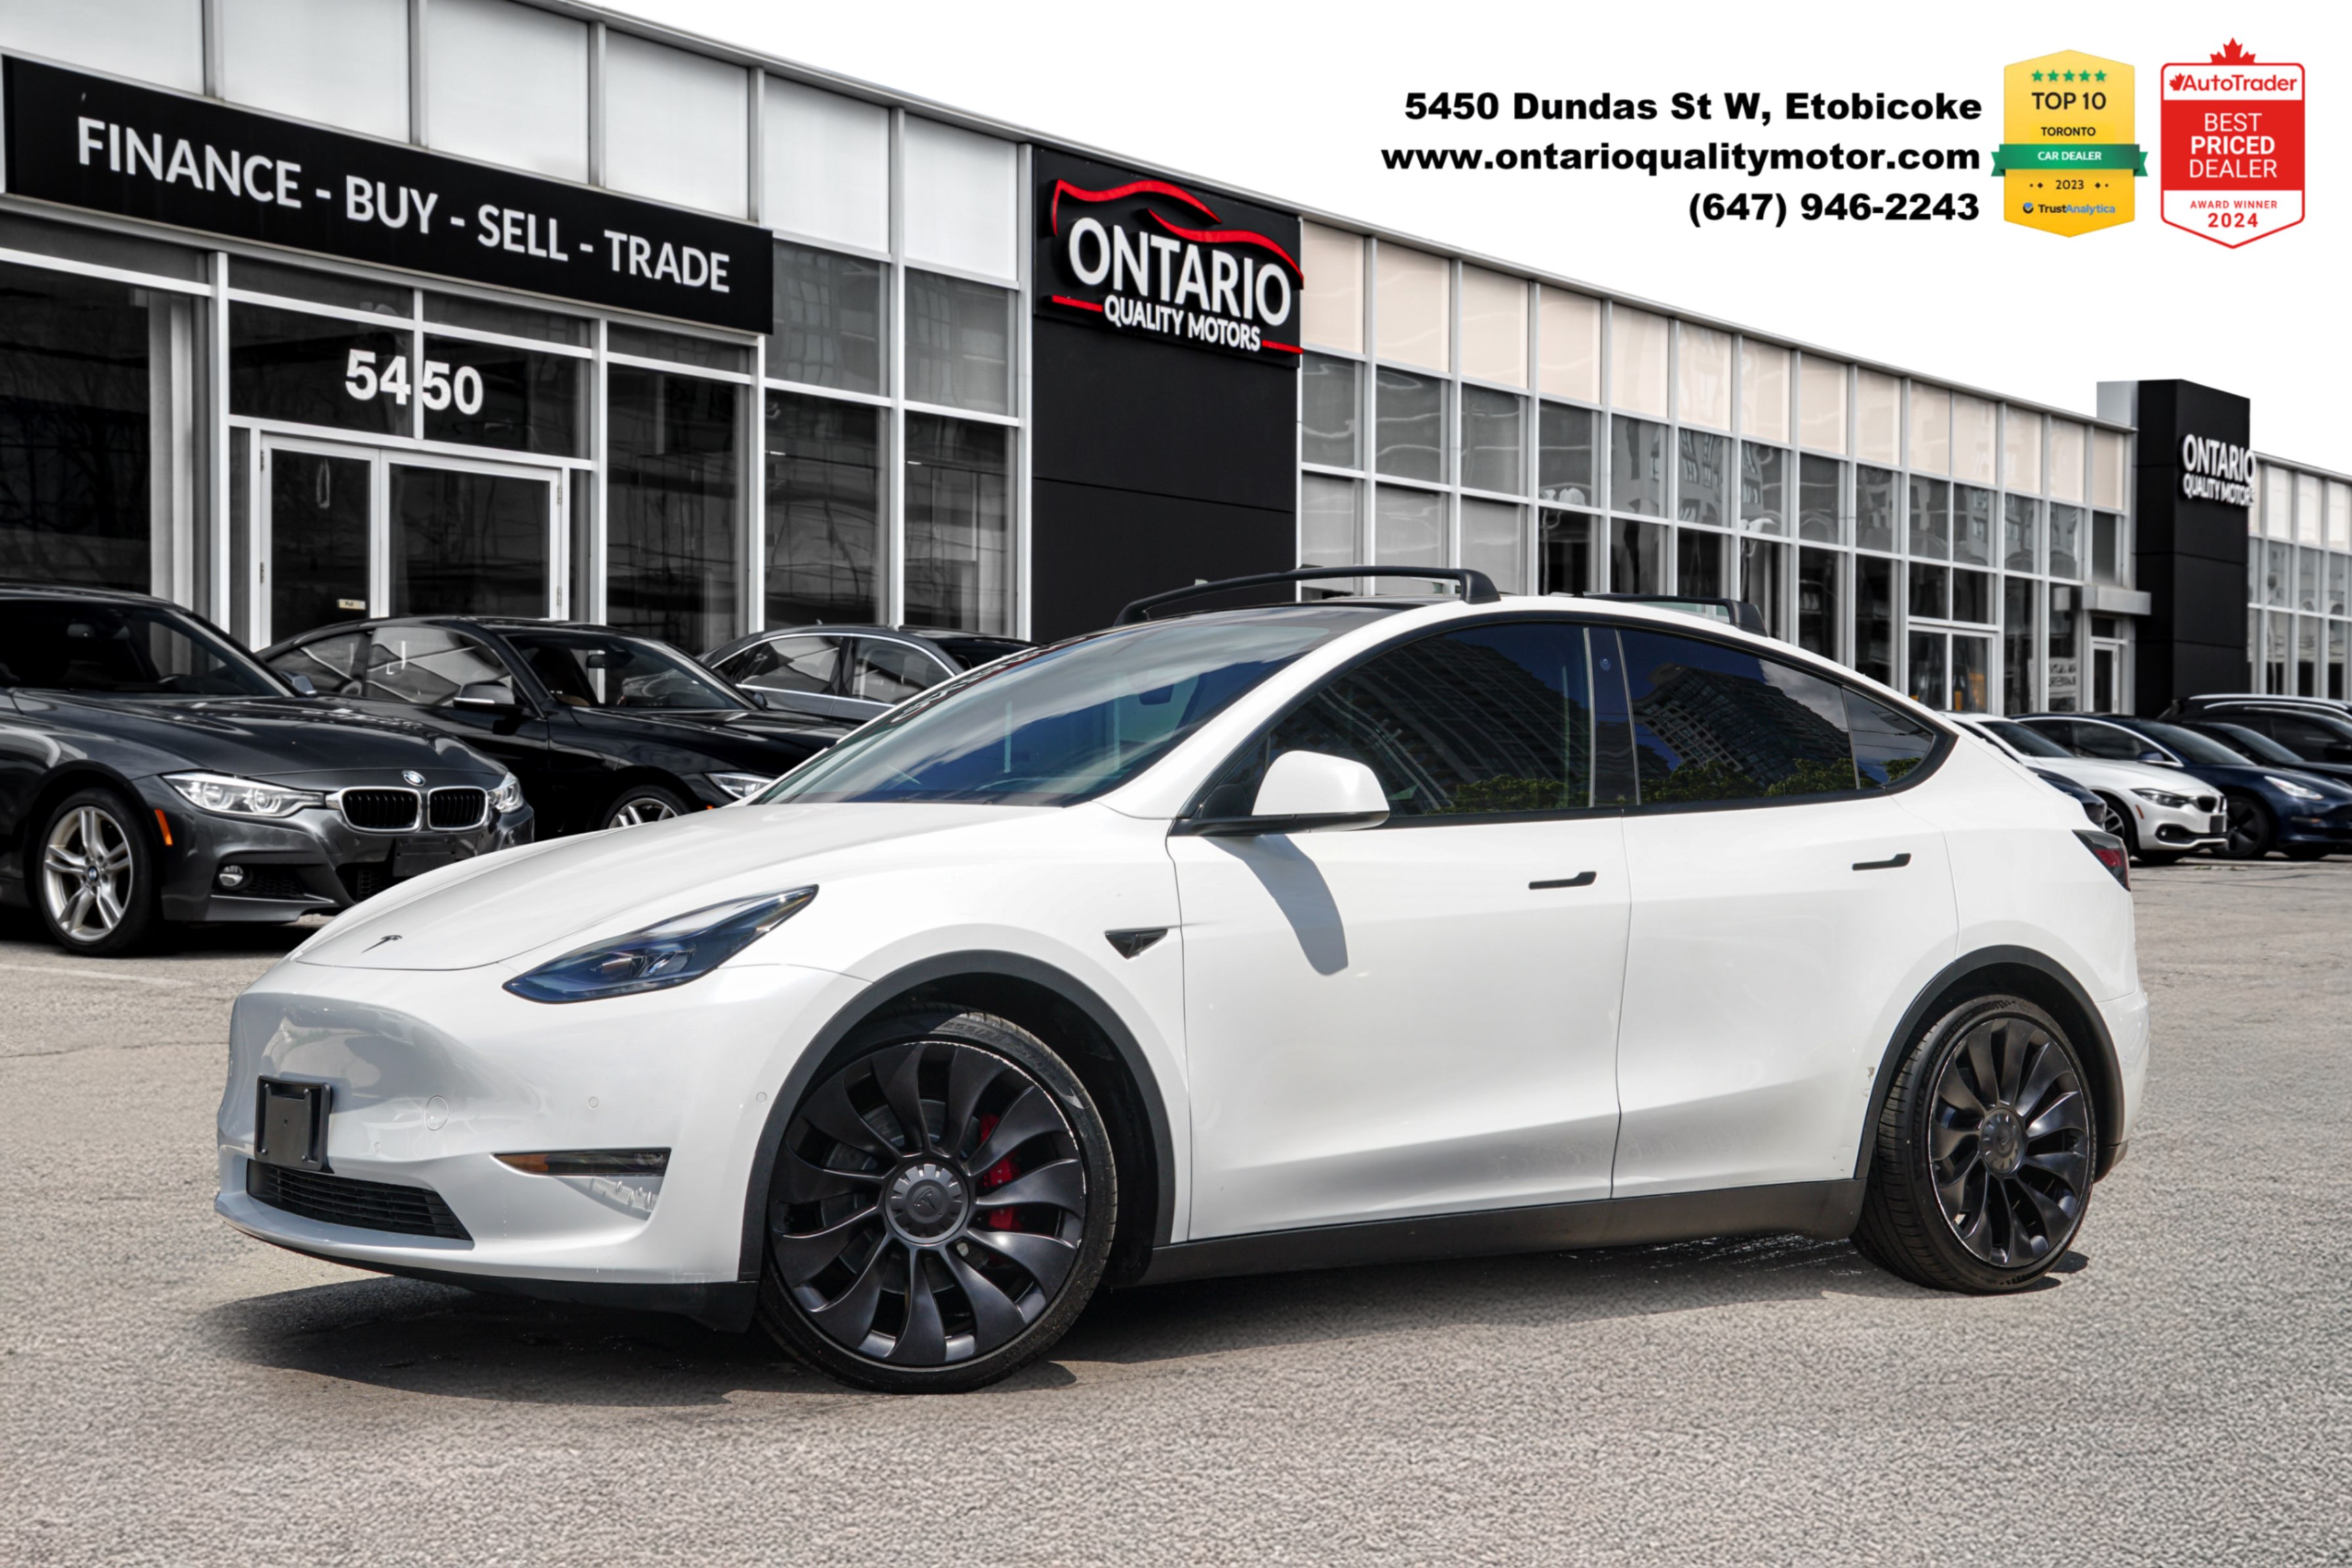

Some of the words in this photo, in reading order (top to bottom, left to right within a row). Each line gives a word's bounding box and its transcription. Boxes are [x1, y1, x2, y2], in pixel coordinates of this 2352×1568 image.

[79, 117, 301, 208] FINANCE
[346, 175, 438, 234] BUY
[478, 204, 568, 261] SELL
[604, 229, 729, 293] TRADE
[1068, 217, 1292, 326] ONTARIO
[1104, 295, 1184, 336] QUALITY
[1188, 312, 1261, 352] MOTORS
[345, 349, 483, 415] 5450
[2182, 472, 2221, 500] QUALITY
[2183, 434, 2256, 485] ONTARIO
